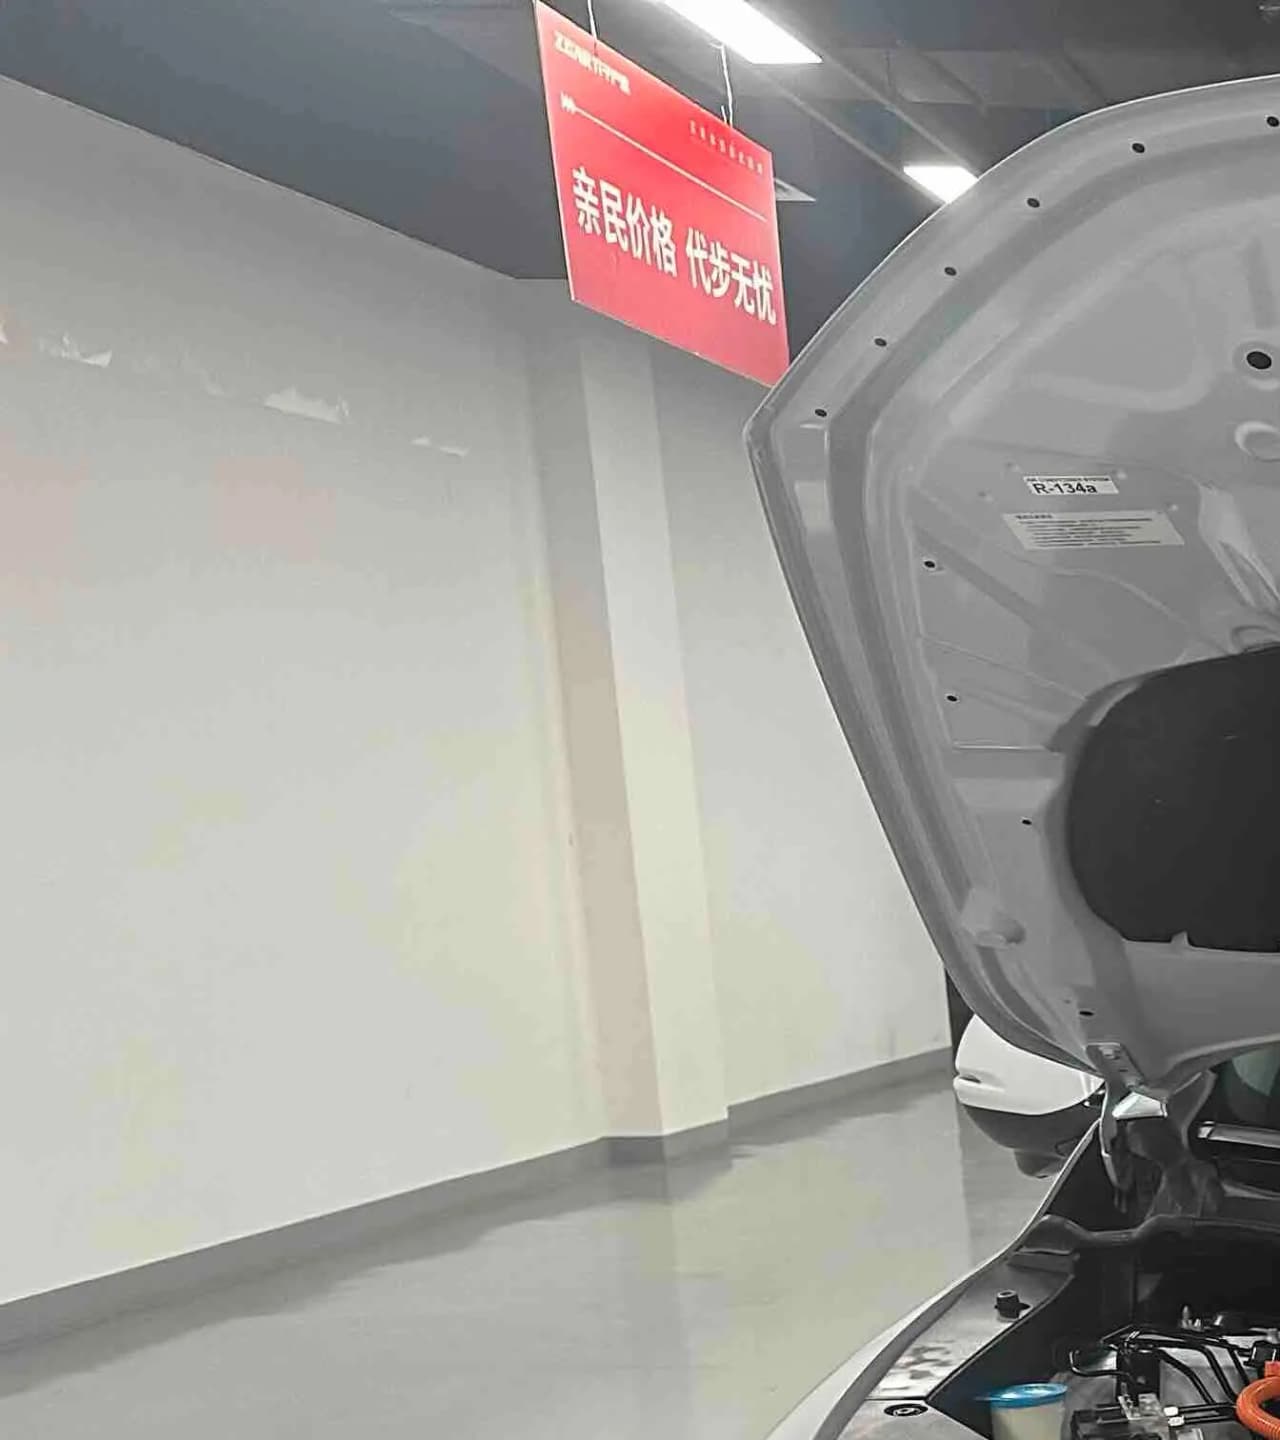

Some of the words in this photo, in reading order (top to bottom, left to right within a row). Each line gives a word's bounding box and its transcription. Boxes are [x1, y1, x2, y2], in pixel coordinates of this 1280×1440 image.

[572, 167, 677, 277] 亲民价格
[686, 227, 776, 325] 代步无忧
[1032, 483, 1098, 494] R-134a
